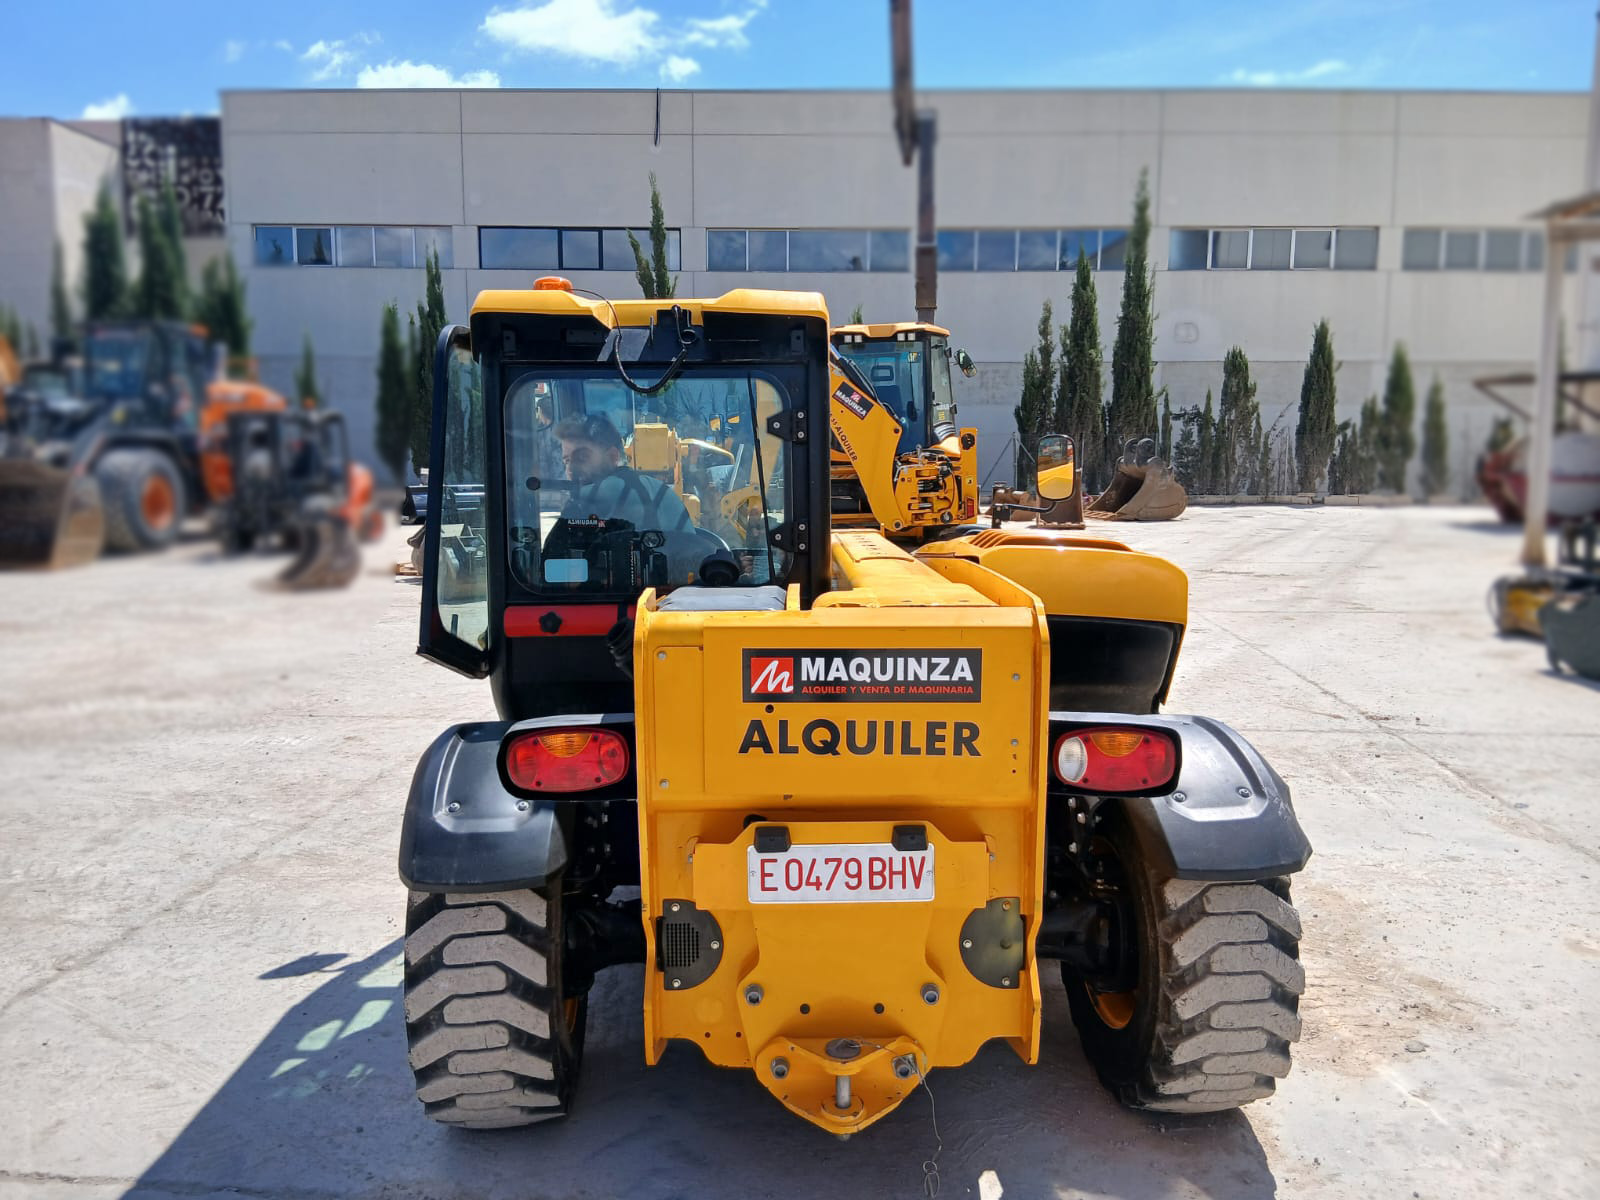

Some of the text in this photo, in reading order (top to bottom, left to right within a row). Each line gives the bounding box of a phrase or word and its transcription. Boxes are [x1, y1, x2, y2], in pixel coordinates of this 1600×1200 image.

[835, 390, 867, 416] MAQUINZA
[835, 426, 858, 461] ALQUILER
[800, 656, 974, 683] MAQUINZA
[801, 685, 974, 694] ALQUILER Y VENTA DE MAQUINARIA
[739, 718, 982, 756] ALQUILER
